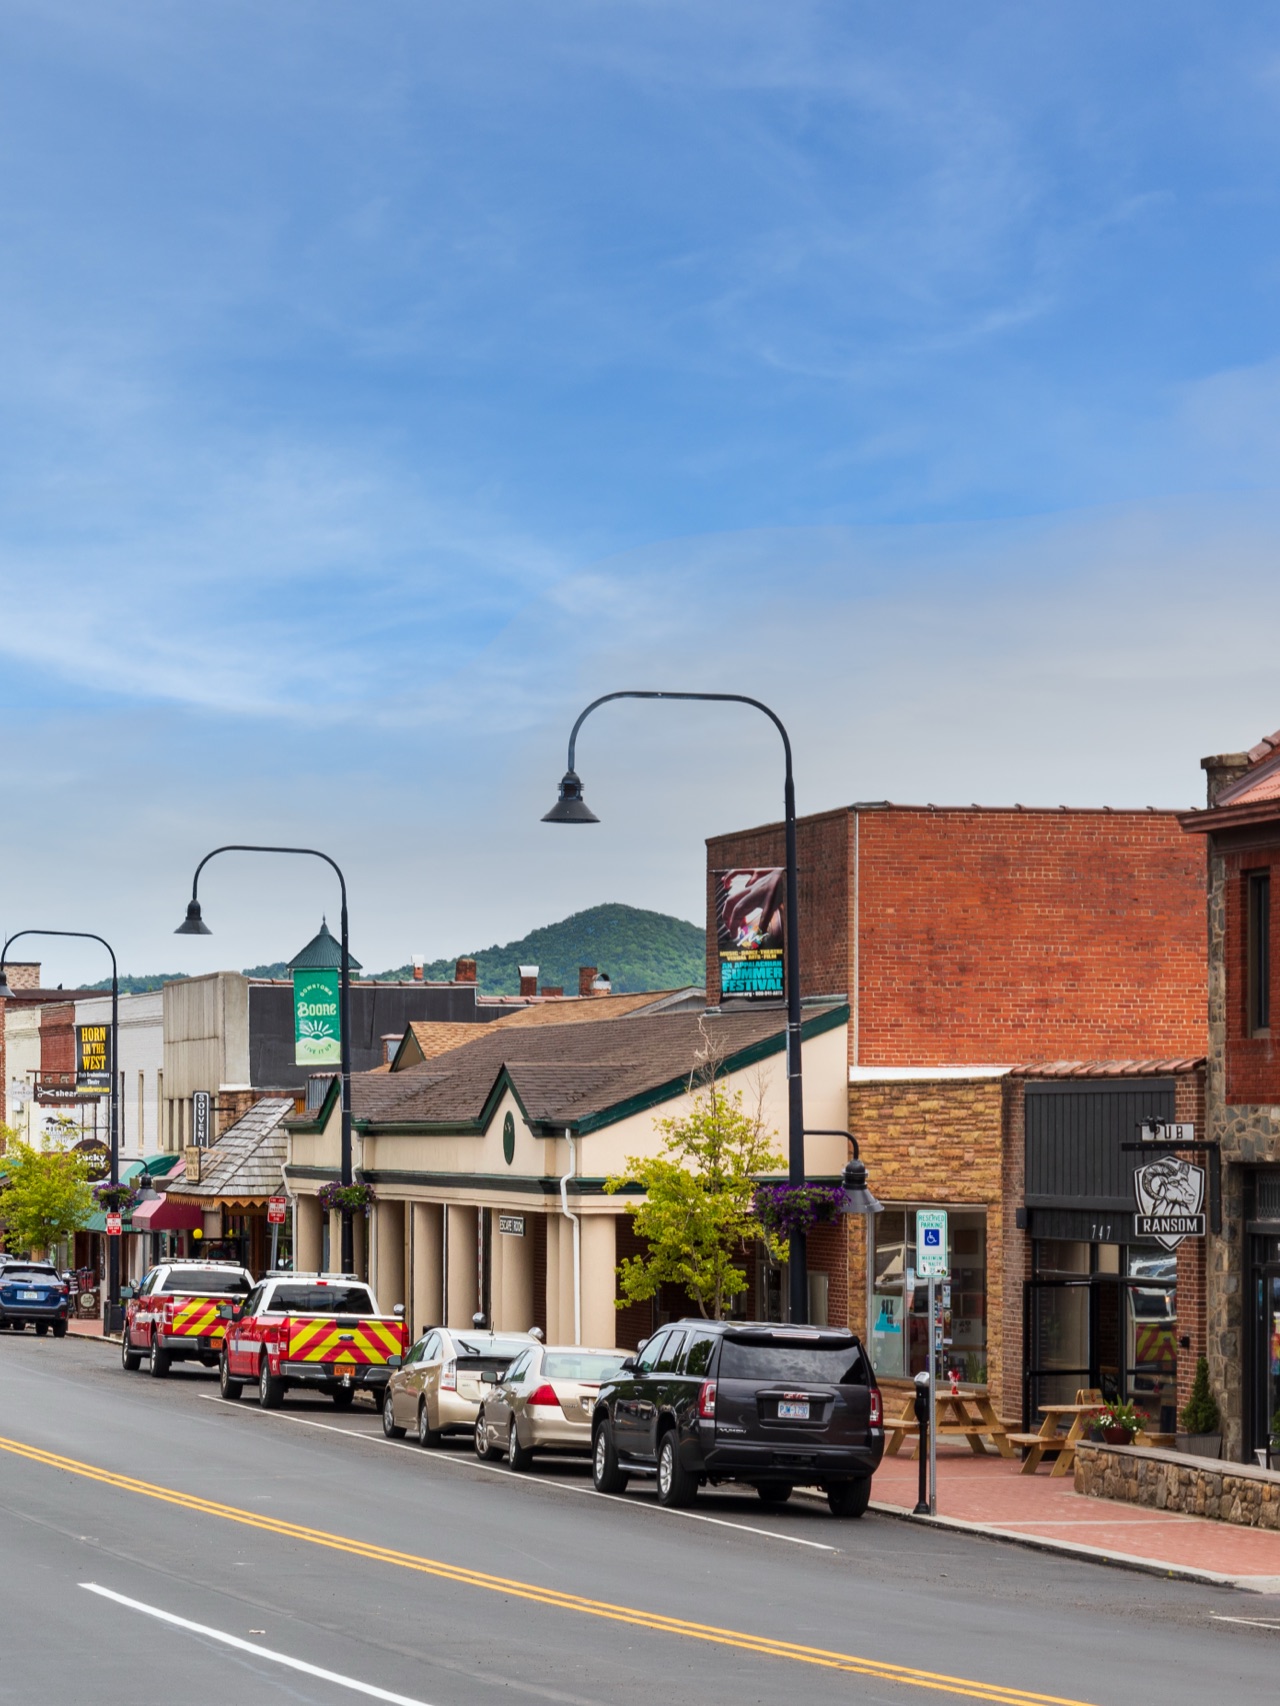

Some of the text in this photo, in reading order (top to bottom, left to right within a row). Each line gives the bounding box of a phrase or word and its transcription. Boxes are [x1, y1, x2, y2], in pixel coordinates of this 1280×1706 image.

[722, 968, 783, 980] SUMMER
[300, 983, 333, 997] DOWNTOWN
[722, 979, 783, 992] FESTIVAL
[297, 1002, 337, 1017] Boone
[81, 1027, 106, 1042] HORN
[82, 1042, 105, 1054] IN THE
[304, 1044, 316, 1054] LIVE
[82, 1055, 106, 1070] WEST
[197, 1094, 205, 1146] SOUVENI
[500, 1219, 512, 1231] ESCAPE
[1092, 1224, 1111, 1240] 747
[1143, 1218, 1197, 1232] RANSOM
